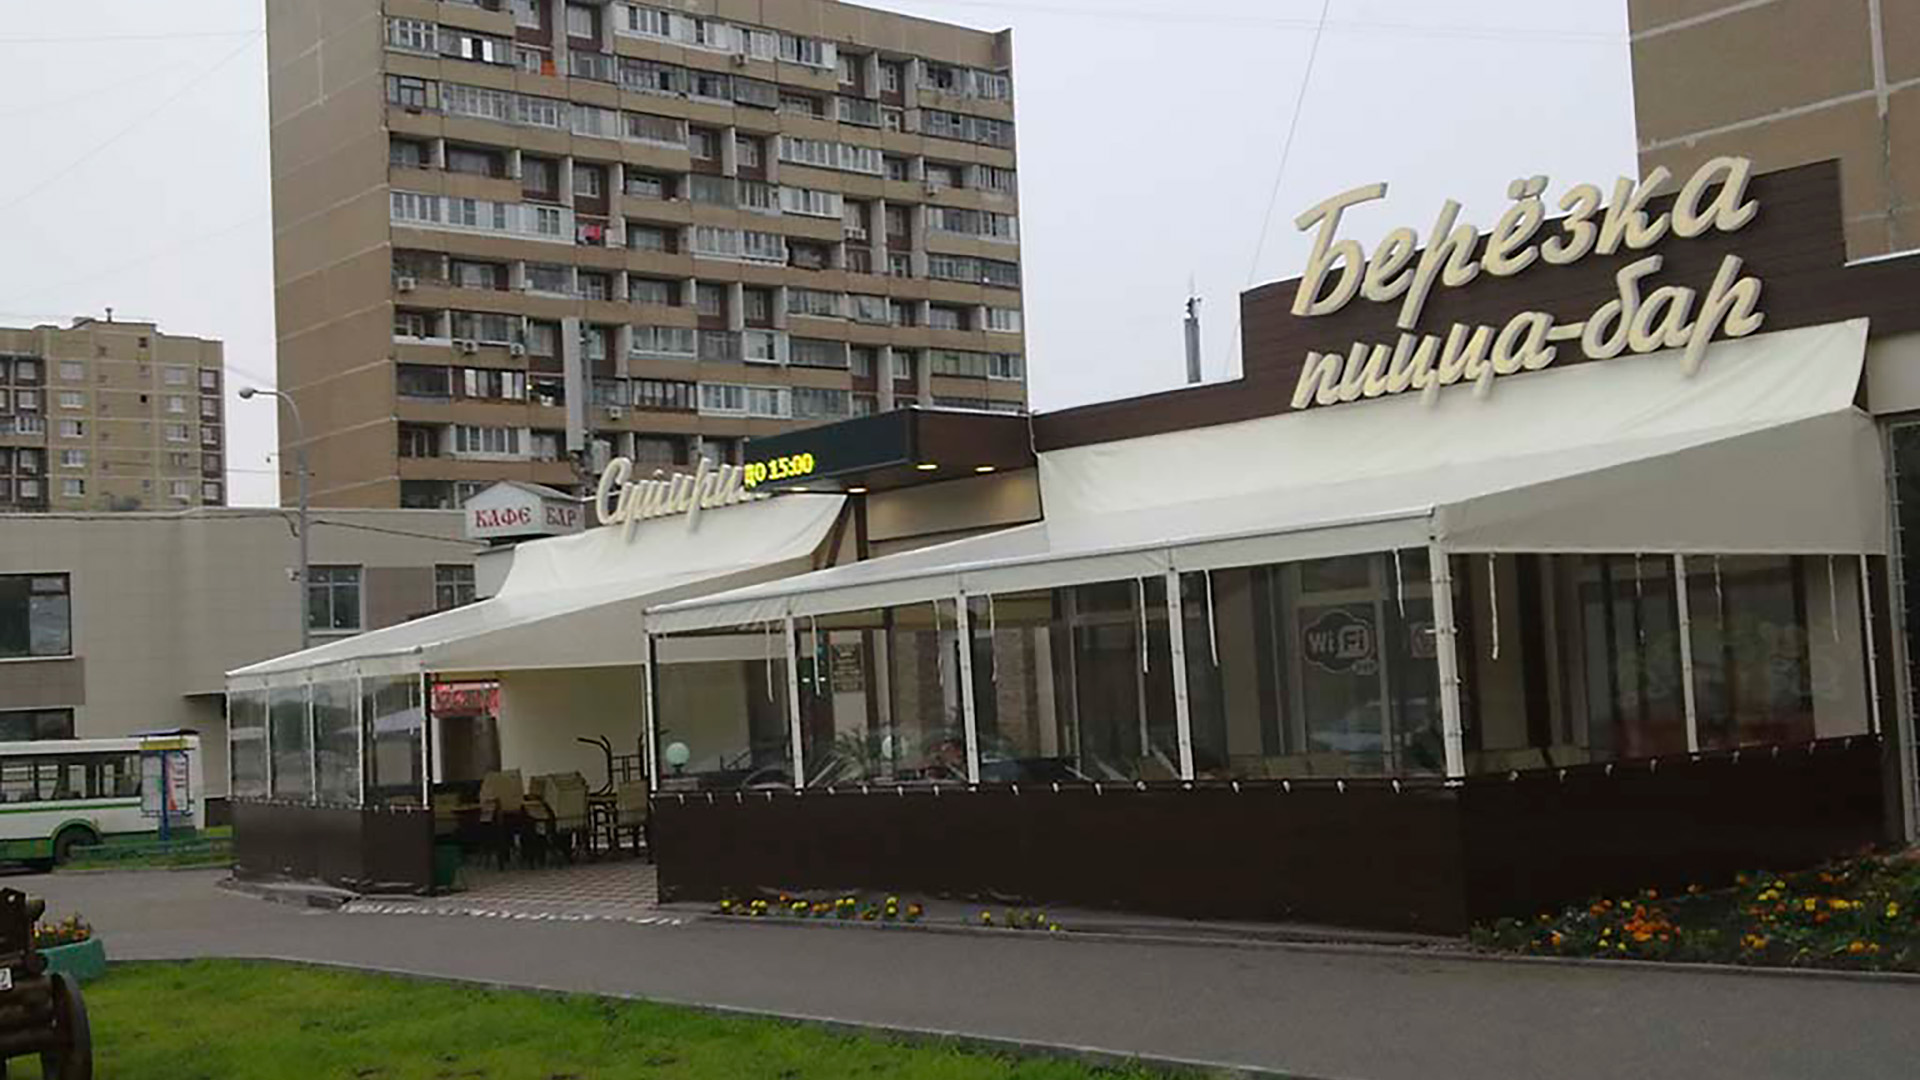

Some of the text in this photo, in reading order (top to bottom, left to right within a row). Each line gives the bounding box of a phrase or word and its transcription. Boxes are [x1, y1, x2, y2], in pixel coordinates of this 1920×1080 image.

[1290, 156, 1760, 329] Берёзка
[1290, 254, 1765, 412] пицца-бар
[768, 452, 815, 479] 15:00
[475, 506, 532, 528] КАФЕ
[545, 506, 577, 527] БАР
